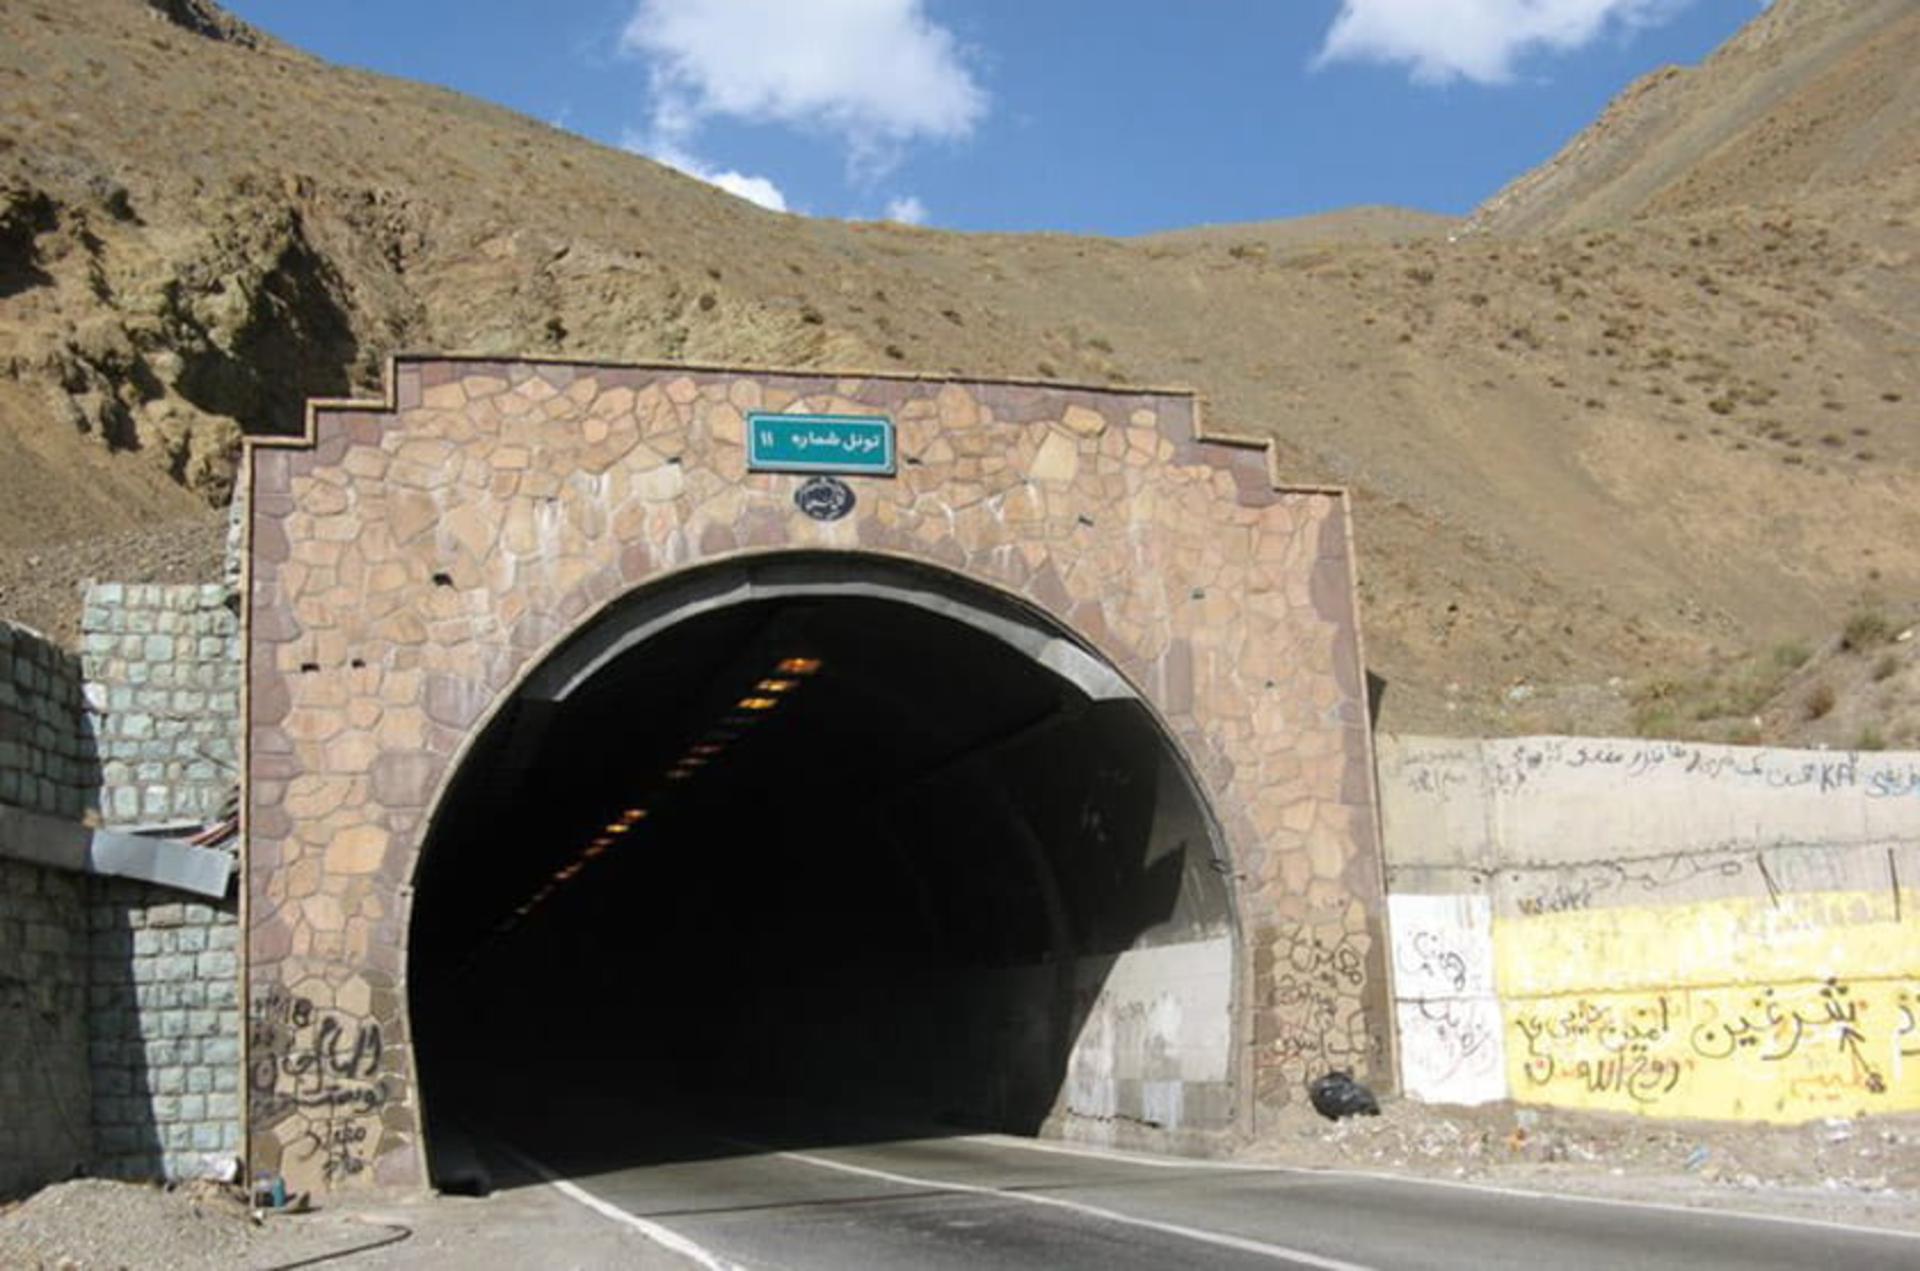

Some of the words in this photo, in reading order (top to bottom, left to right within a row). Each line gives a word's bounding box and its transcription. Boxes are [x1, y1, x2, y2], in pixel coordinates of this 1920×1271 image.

[760, 429, 774, 448] ۱۱
[791, 430, 841, 449] شماره
[842, 433, 880, 452] تونل
